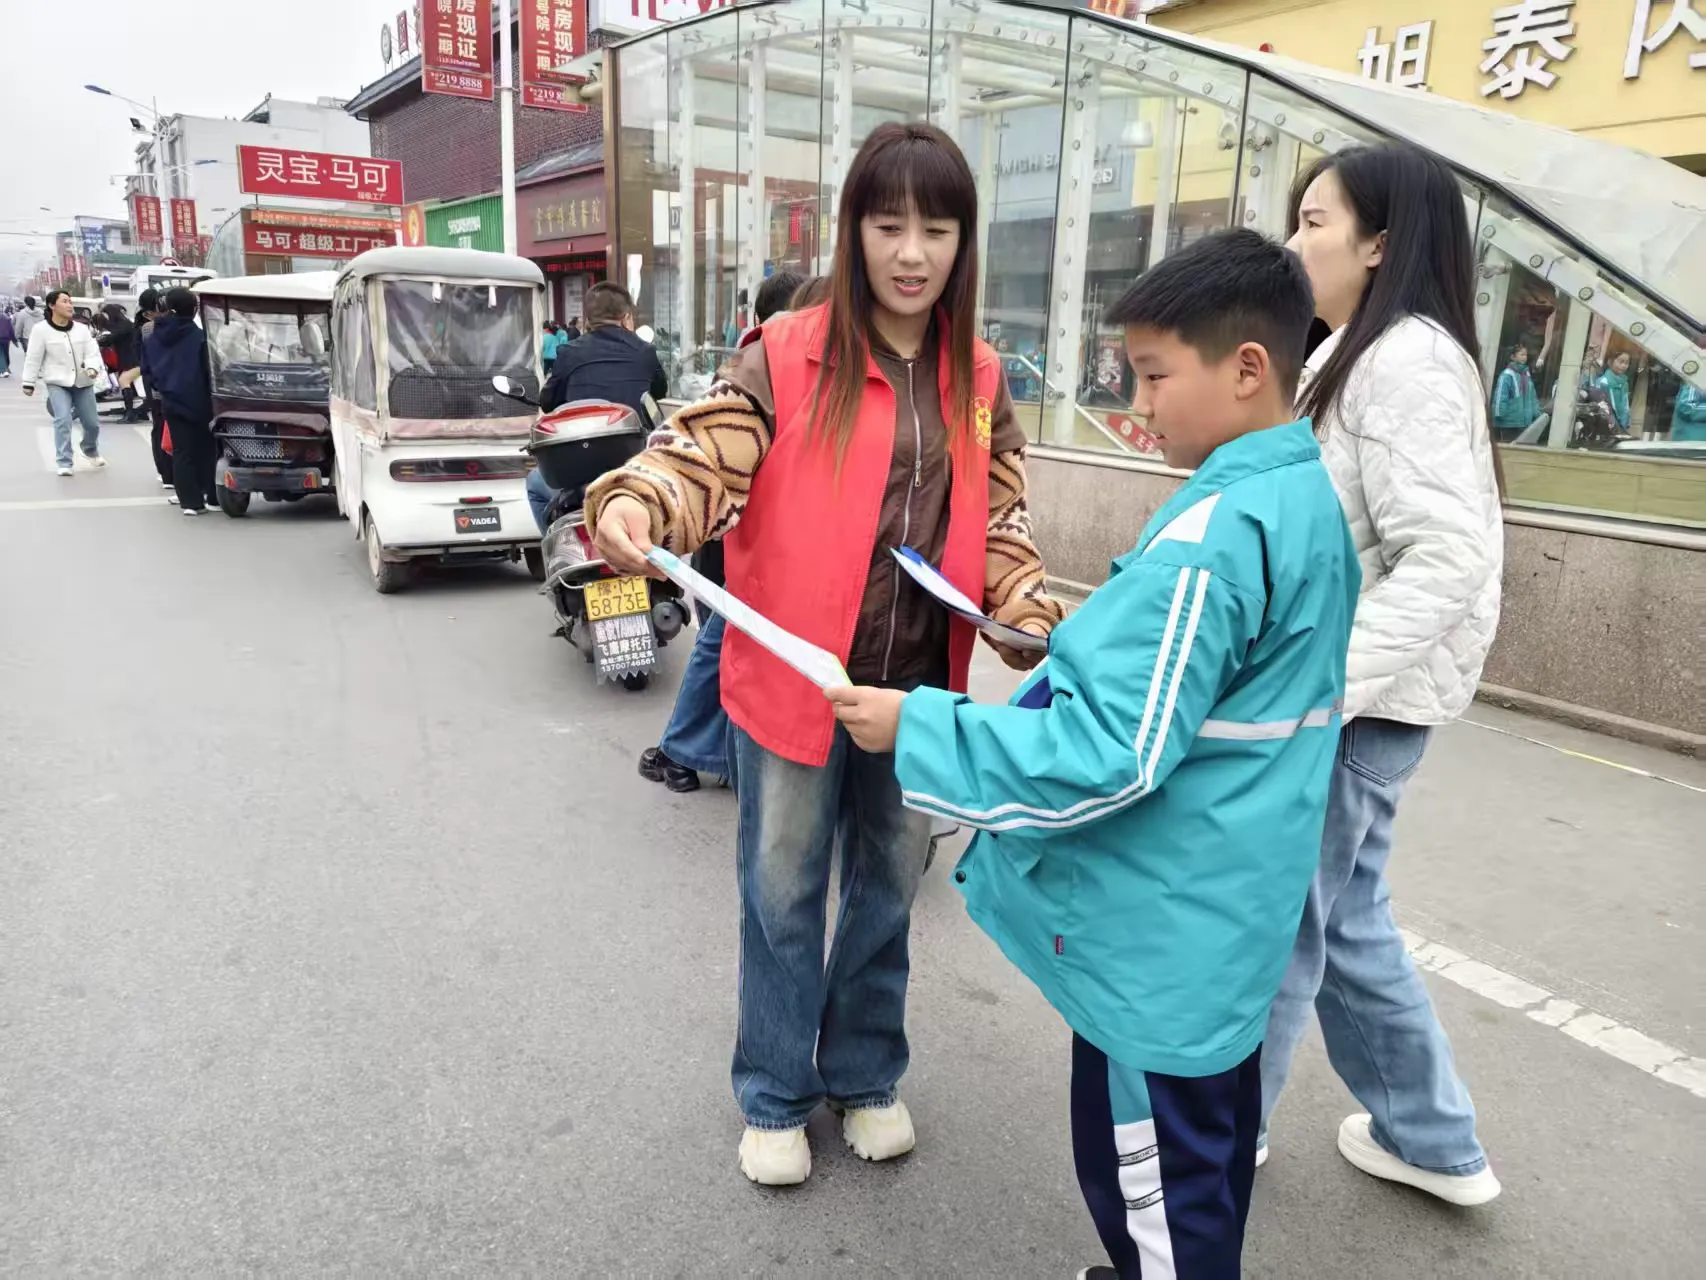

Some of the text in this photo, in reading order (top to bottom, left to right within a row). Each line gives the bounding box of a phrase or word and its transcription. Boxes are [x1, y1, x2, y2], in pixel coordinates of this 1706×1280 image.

[439, 73, 457, 83] 219
[459, 76, 483, 89] 8888
[537, 89, 555, 99] 219
[255, 151, 391, 193] 灵宝·马可
[590, 592, 647, 617] 5873E
